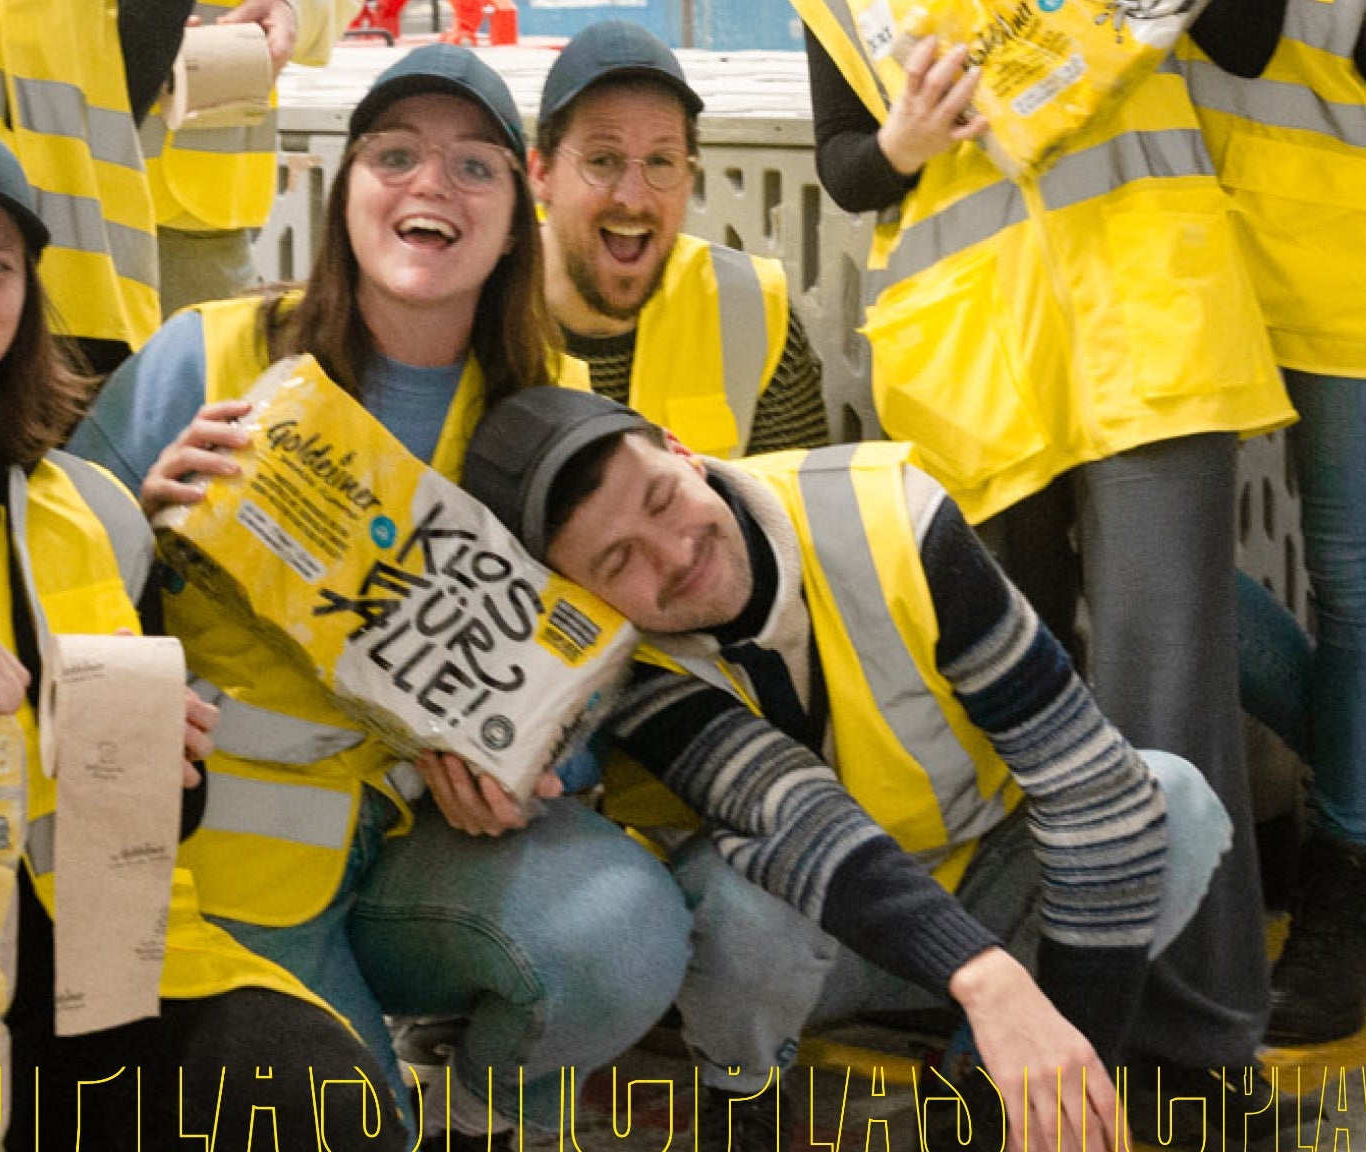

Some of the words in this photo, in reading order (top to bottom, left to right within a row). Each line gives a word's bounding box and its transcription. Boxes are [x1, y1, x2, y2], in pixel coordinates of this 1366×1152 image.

[267, 419, 383, 511] Goldeimer
[357, 559, 526, 692] FÜR
[395, 501, 546, 643] KLOS
[312, 587, 493, 728] ALLE!
